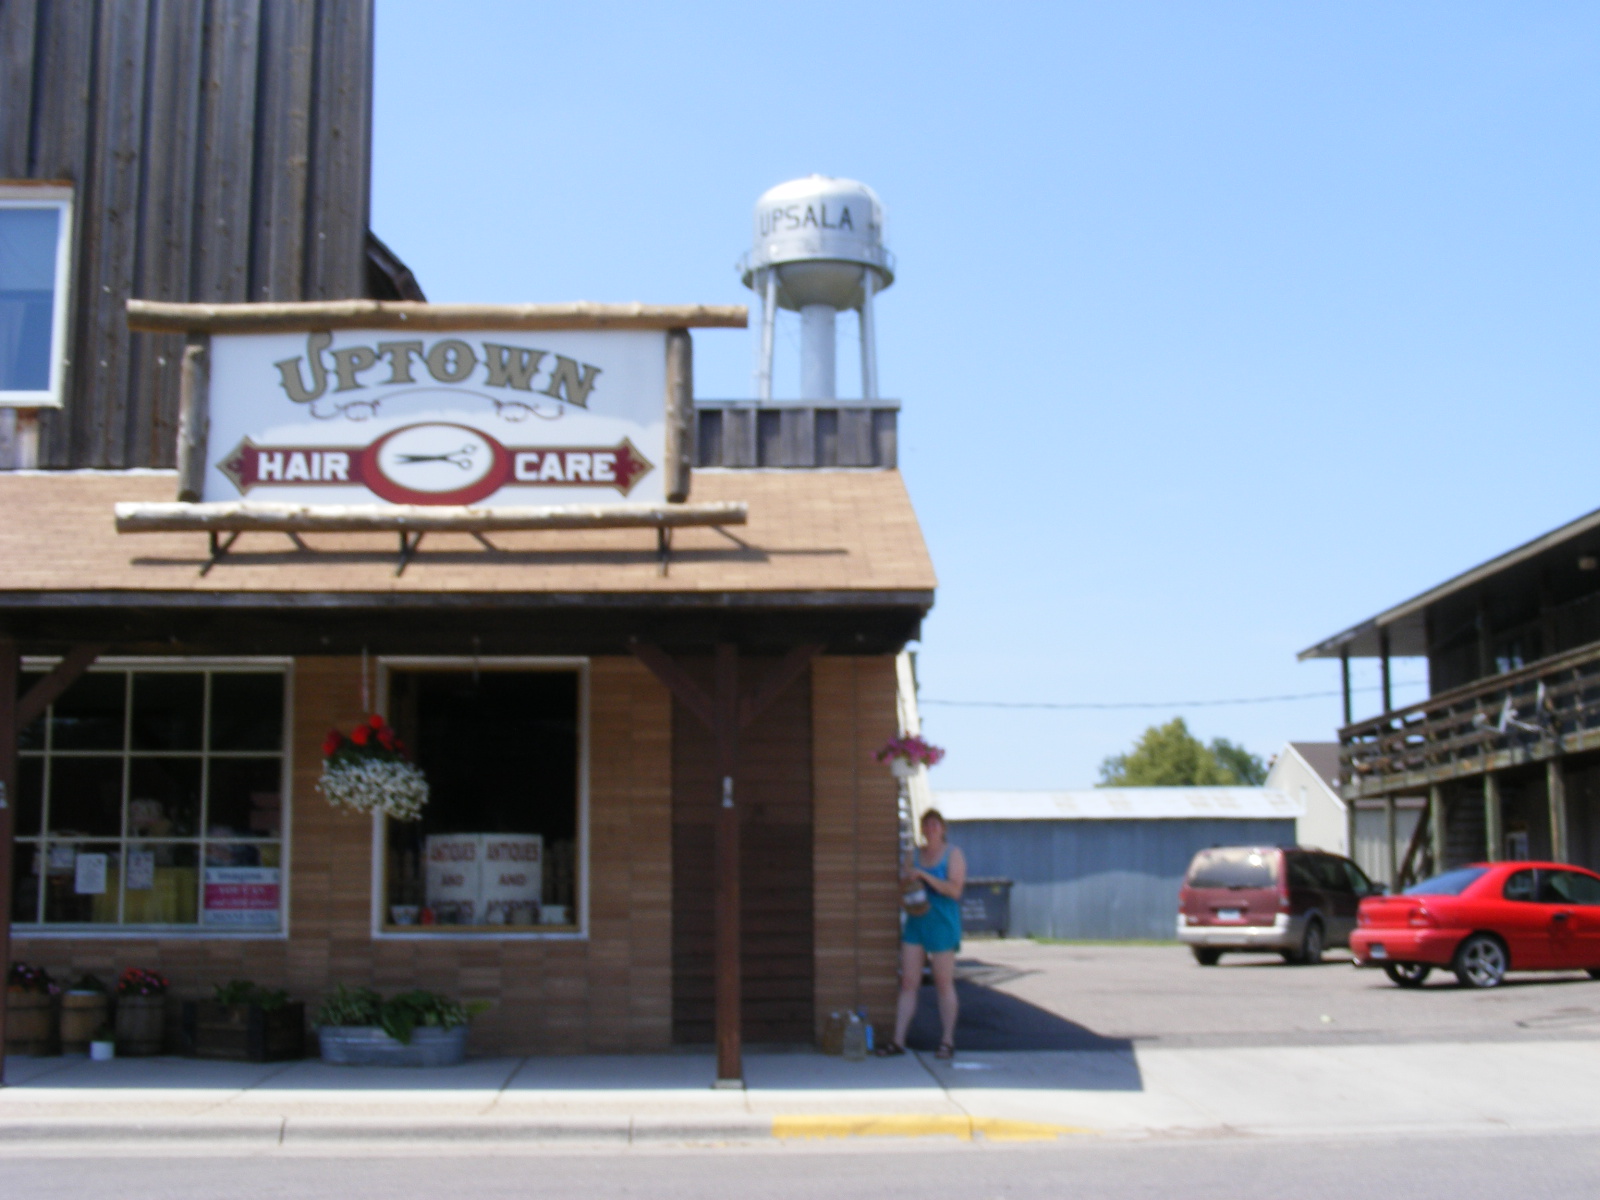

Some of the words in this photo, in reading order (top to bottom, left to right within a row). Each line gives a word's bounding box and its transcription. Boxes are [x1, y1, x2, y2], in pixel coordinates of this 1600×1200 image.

[760, 204, 854, 236] UPSALA
[274, 330, 602, 410] UPTOWN
[257, 452, 350, 481] HAIR
[514, 452, 617, 482] CARE
